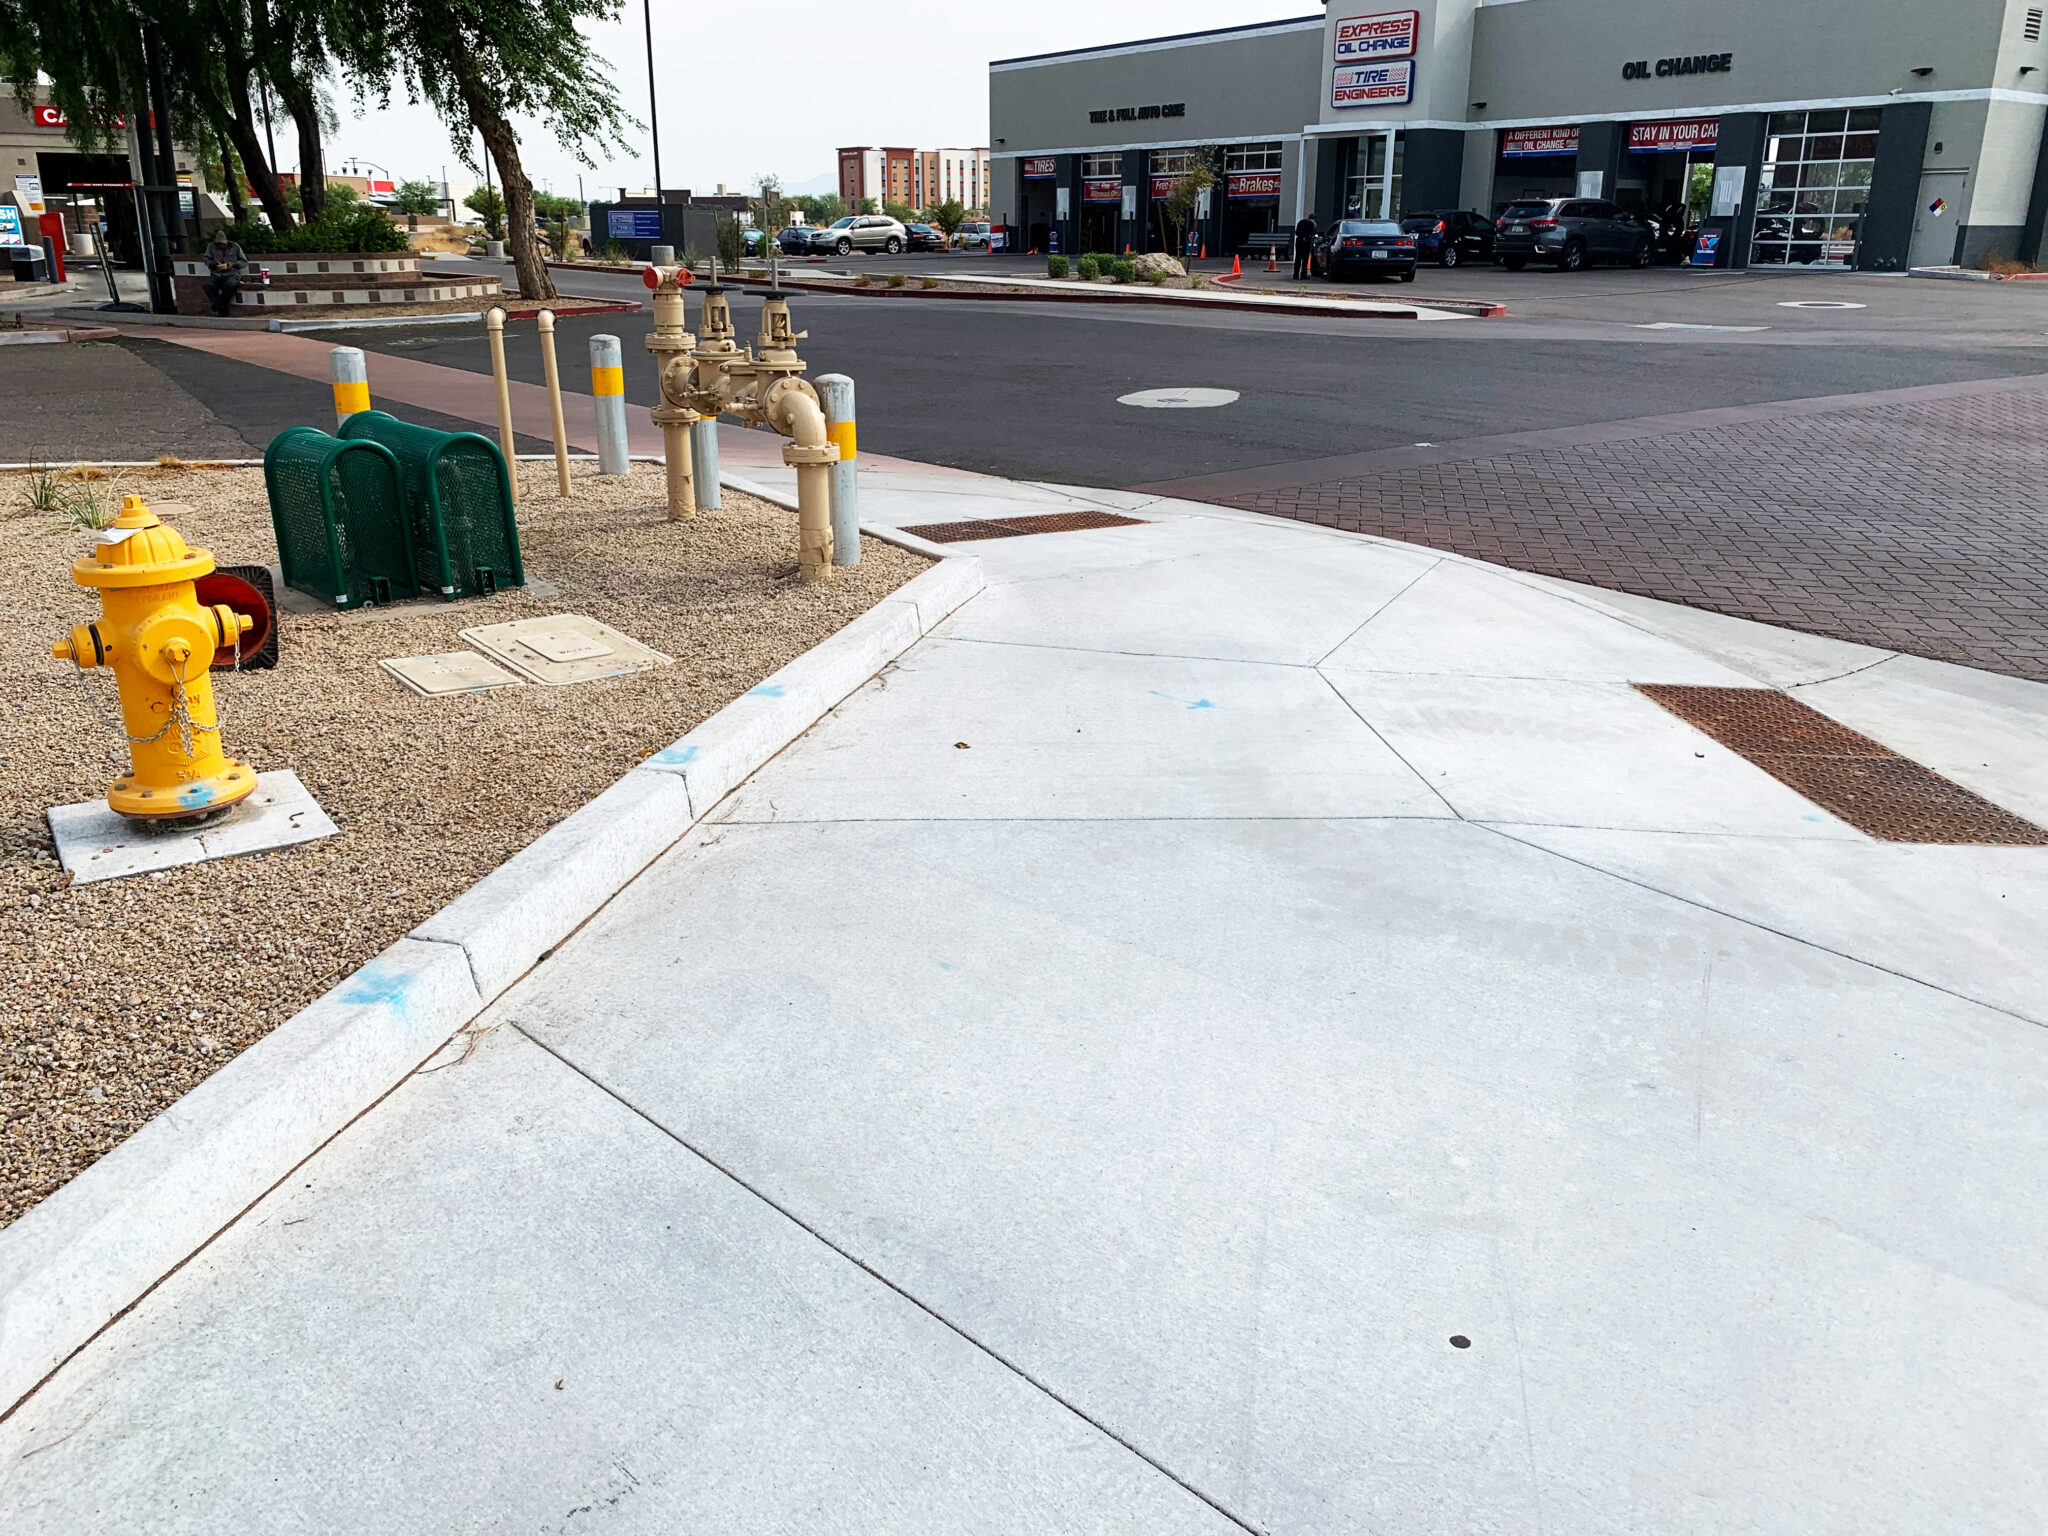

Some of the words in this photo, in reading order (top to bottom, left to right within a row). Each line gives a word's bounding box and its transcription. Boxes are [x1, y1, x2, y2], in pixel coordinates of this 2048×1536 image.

[1339, 18, 1412, 38] EXPRESS
[1337, 42, 1357, 54] OIL
[1359, 36, 1410, 53] CHANGE
[1622, 61, 1651, 79] OIL
[1655, 53, 1733, 77] CHANGE
[1354, 69, 1390, 84] TIRE
[1334, 85, 1406, 101] ENGINEERS
[1116, 107, 1137, 121] FULL
[1137, 105, 1160, 120] AUTO
[1161, 103, 1185, 118] CARE
[1508, 131, 1514, 140] A
[1514, 129, 1552, 140] DIFFERENT
[1552, 128, 1570, 138] KIND
[1632, 126, 1658, 141] STAY
[1659, 126, 1670, 140] IN
[1672, 124, 1699, 140] YOUR
[1523, 141, 1535, 150] OIL
[1536, 139, 1565, 149] CHANGE
[1034, 158, 1055, 173] TIRES
[1239, 178, 1274, 193] Brakes
